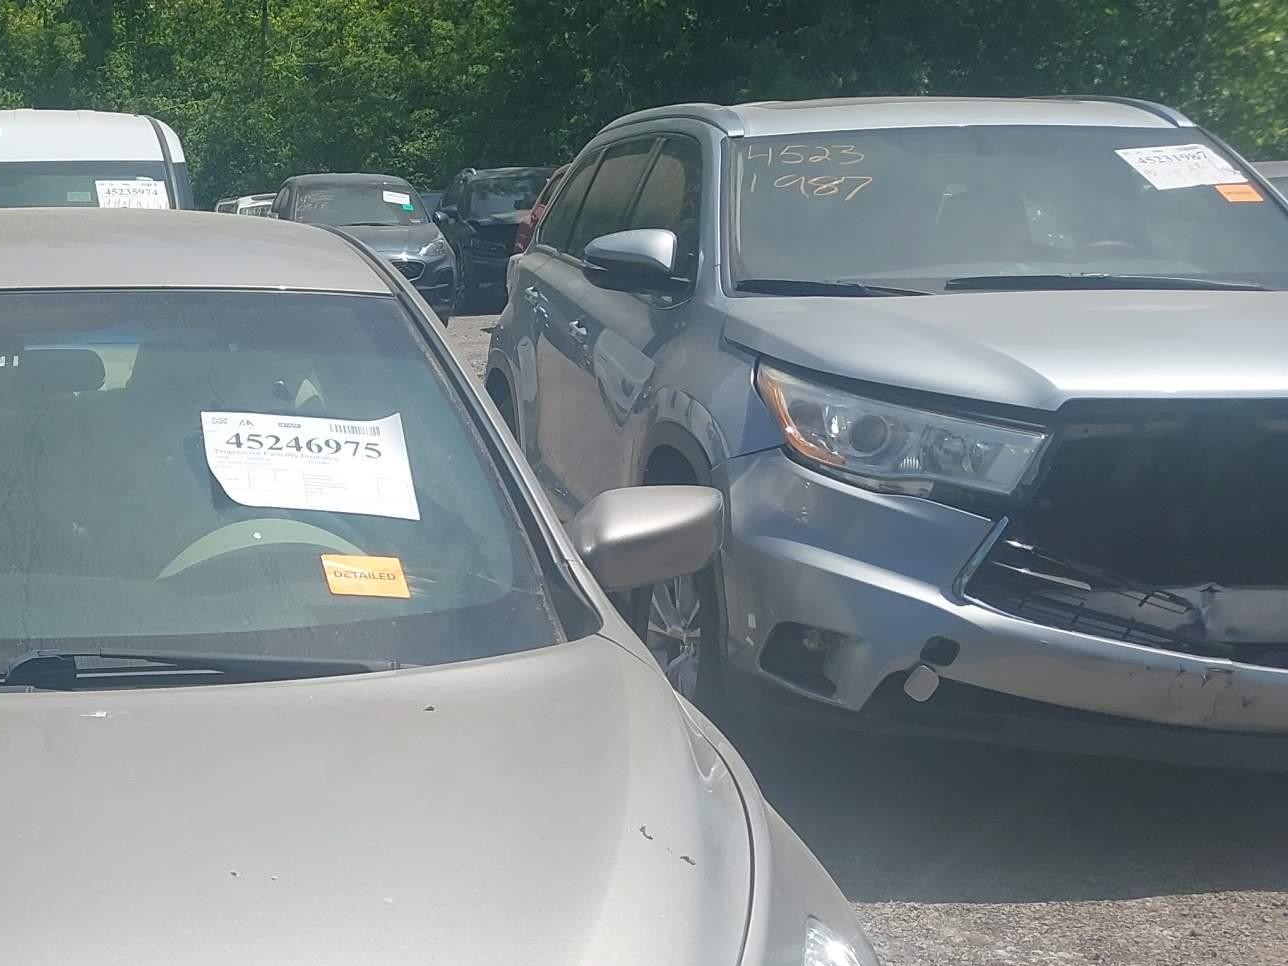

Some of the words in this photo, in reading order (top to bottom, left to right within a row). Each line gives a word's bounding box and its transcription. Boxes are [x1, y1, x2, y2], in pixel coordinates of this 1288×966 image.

[748, 145, 865, 166] 4523
[751, 174, 872, 201] 1987
[225, 432, 382, 459] 45246975
[333, 570, 397, 581] DETAILED
